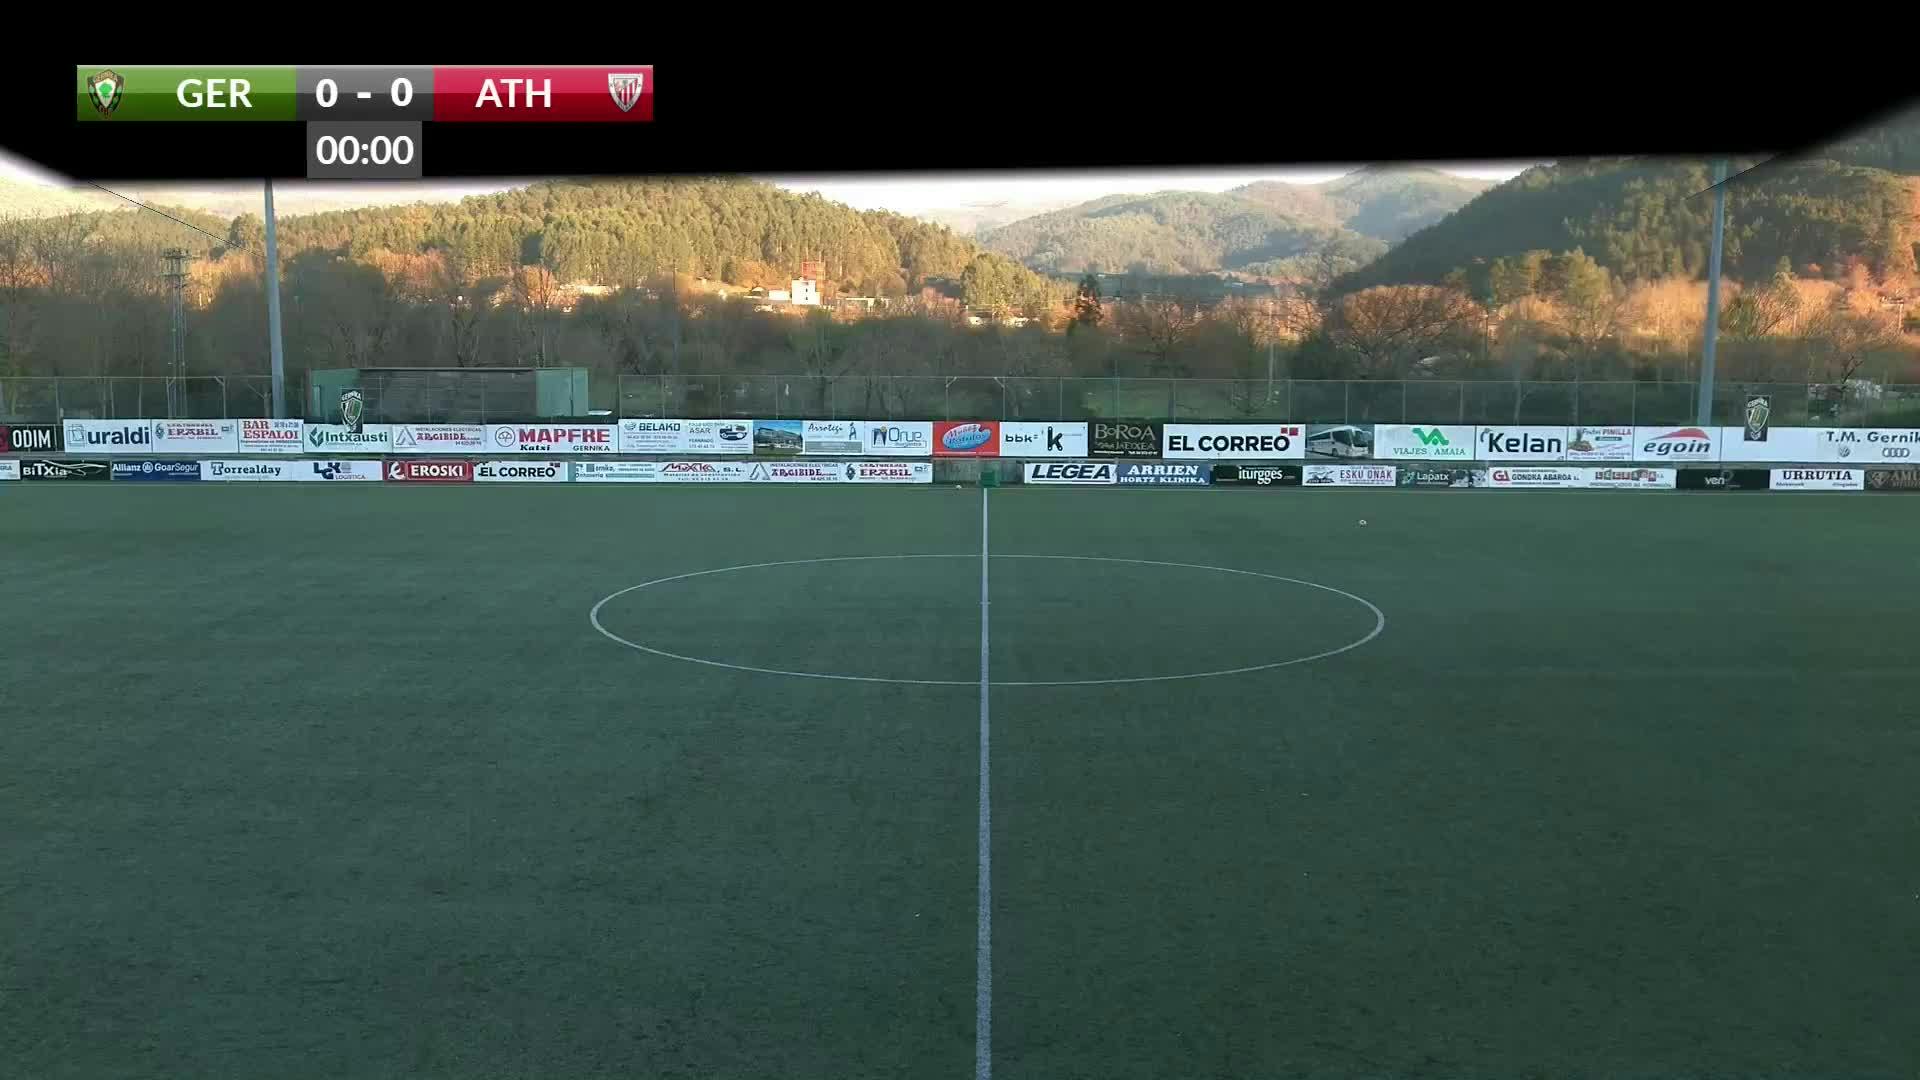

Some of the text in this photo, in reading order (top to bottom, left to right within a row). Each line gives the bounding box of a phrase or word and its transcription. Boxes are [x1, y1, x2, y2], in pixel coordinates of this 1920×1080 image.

[243, 420, 269, 430] BAR
[639, 422, 681, 432] BELAKO
[88, 427, 150, 445] uraldi
[243, 430, 299, 440] ESPALOI
[326, 431, 388, 442] Intxausti
[519, 428, 610, 443] MAPFRE
[1005, 434, 1032, 443] bbk
[1826, 431, 1861, 443] T.M.
[573, 444, 610, 452] GERNIKA
[1168, 435, 1290, 452] EL CORREO
[1488, 432, 1562, 453] Kelan
[1643, 440, 1711, 456] egoin
[1393, 447, 1466, 456] VIAJES AMAIA
[112, 463, 141, 472] Allianz
[211, 462, 281, 476] Torrealday
[410, 465, 463, 477] EROSKI
[480, 466, 556, 478] EL CORREO
[1032, 465, 1110, 479] LEGEA
[1128, 465, 1199, 475] ARRIEN
[1783, 471, 1852, 481] URRUTIA
